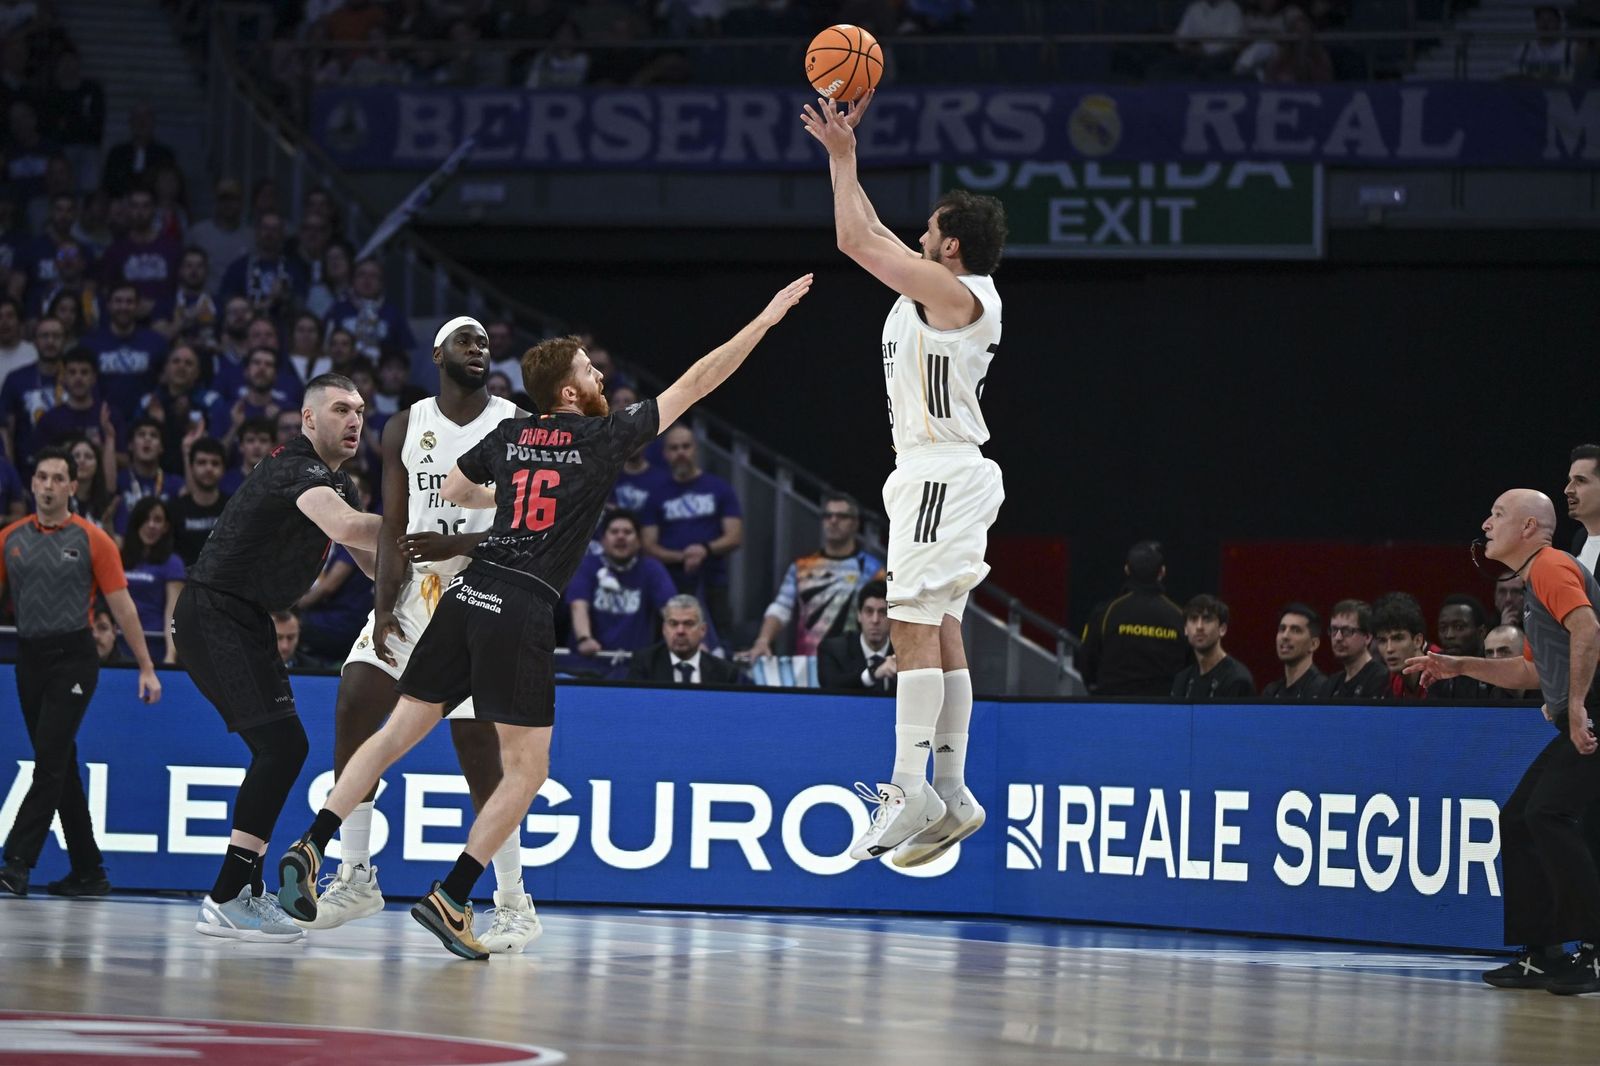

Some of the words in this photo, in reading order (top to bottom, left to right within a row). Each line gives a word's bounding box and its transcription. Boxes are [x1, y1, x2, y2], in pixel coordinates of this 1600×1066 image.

[1181, 87, 1466, 160] REAL
[1047, 197, 1197, 244] EXIT
[506, 443, 583, 465] PULEVA
[511, 468, 561, 532] 16
[455, 592, 468, 602] de
[467, 596, 502, 615] Granada
[460, 584, 503, 605] Diputación
[1118, 624, 1178, 640] PROSEGUR
[1058, 784, 1250, 882] REALE
[1273, 790, 1502, 897] SEGUR
